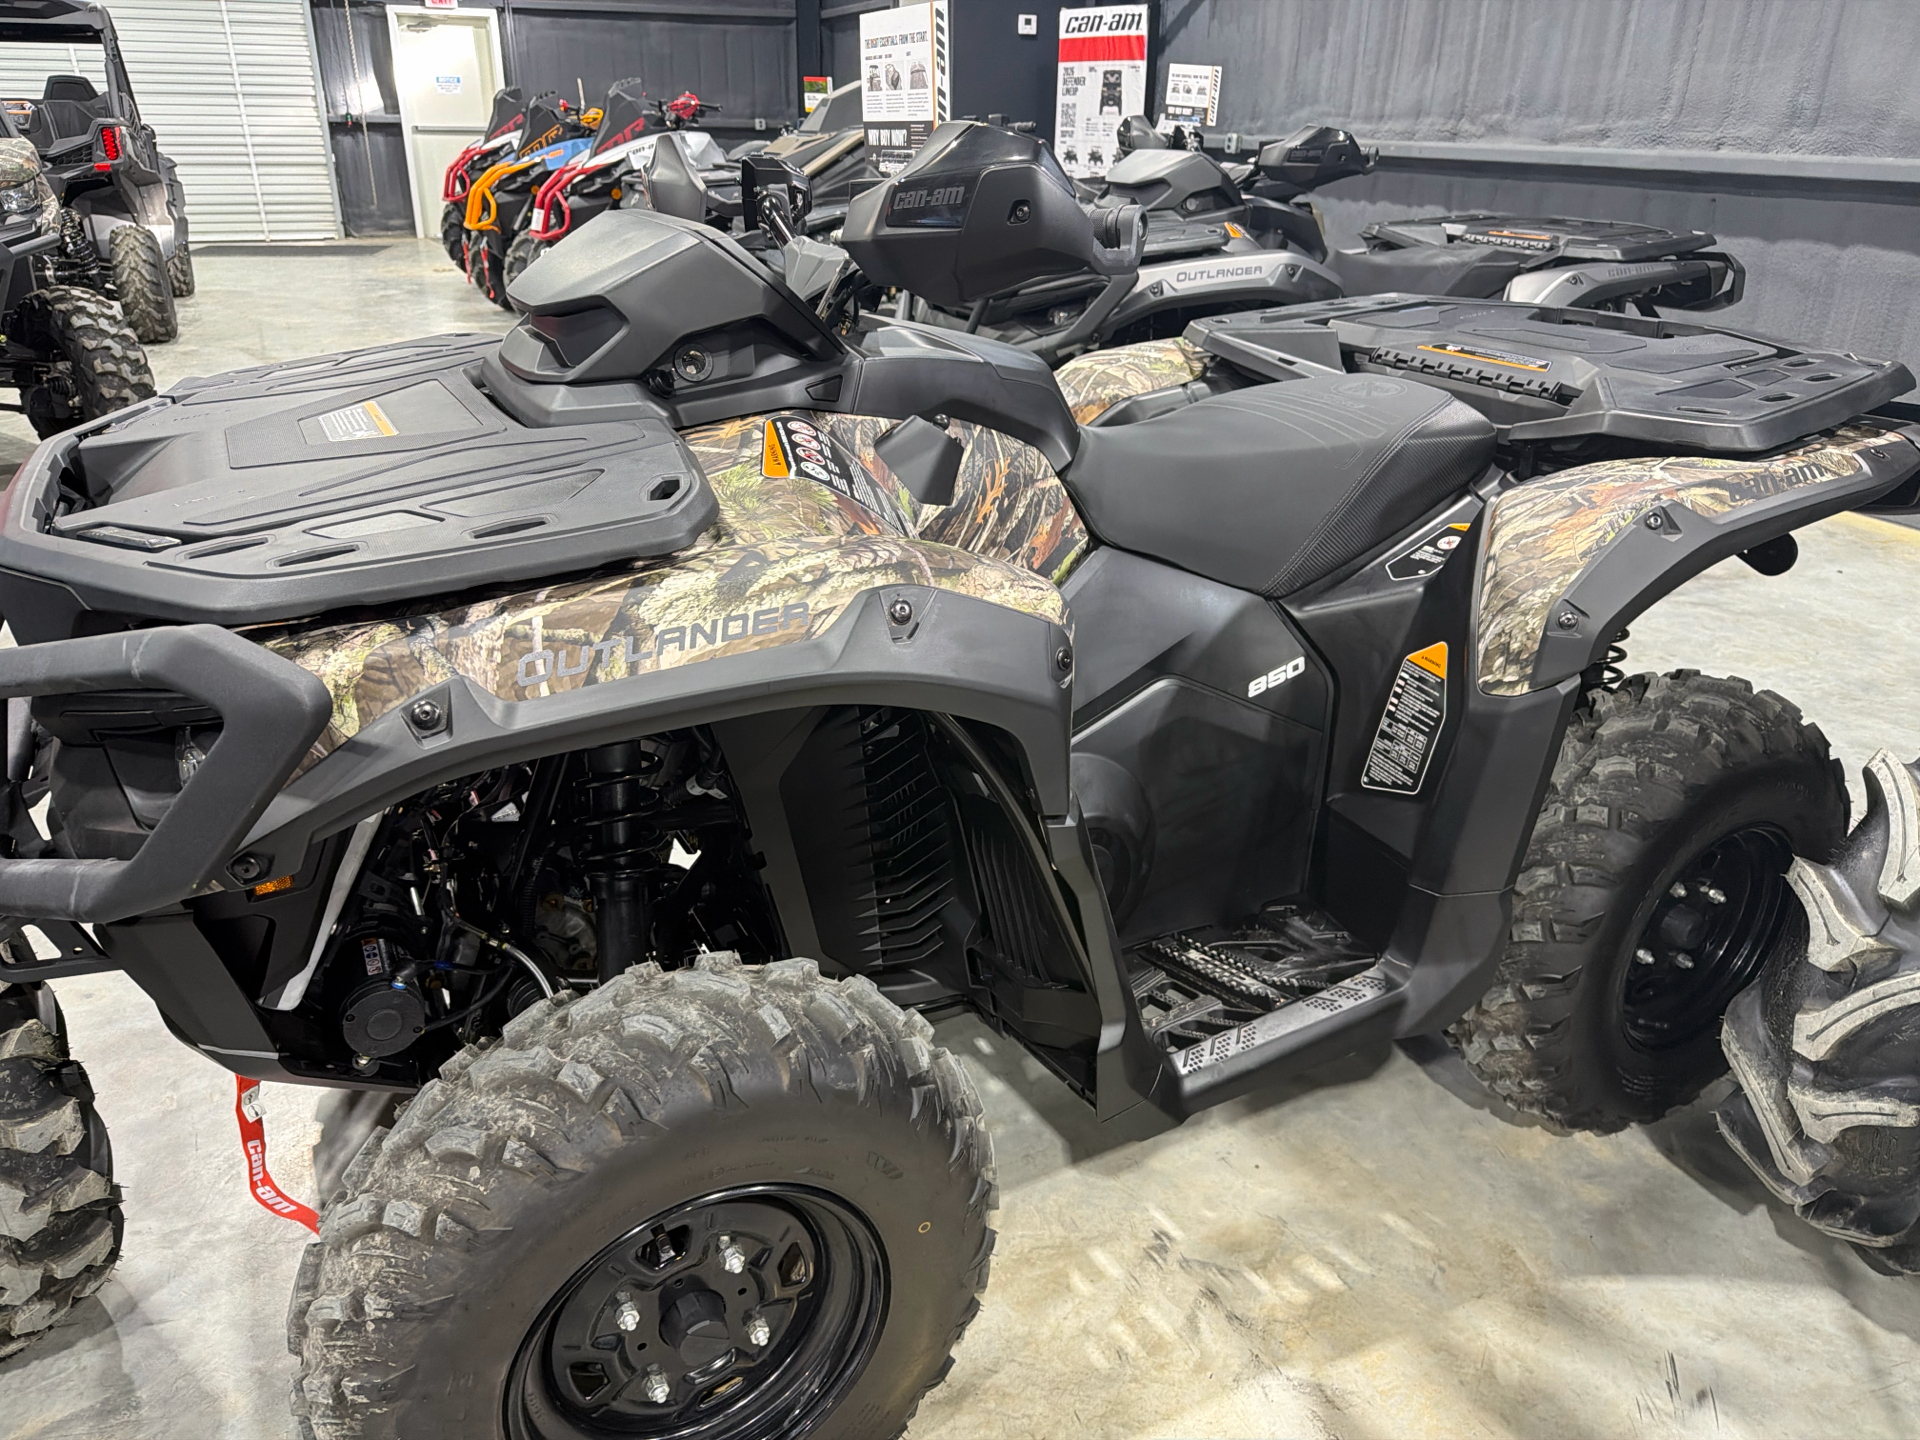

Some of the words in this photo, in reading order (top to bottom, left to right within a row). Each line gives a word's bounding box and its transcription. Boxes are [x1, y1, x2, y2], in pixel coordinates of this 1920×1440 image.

[1065, 12, 1143, 34] can-am
[867, 129, 880, 146] WHY
[879, 128, 891, 146] BUY
[891, 128, 907, 147] NOW?
[893, 186, 965, 210] can-am
[1176, 265, 1263, 283] OUTLANDER
[516, 601, 809, 688] OUTLANDER
[1247, 656, 1306, 698] 850
[246, 1139, 298, 1214] can-am
